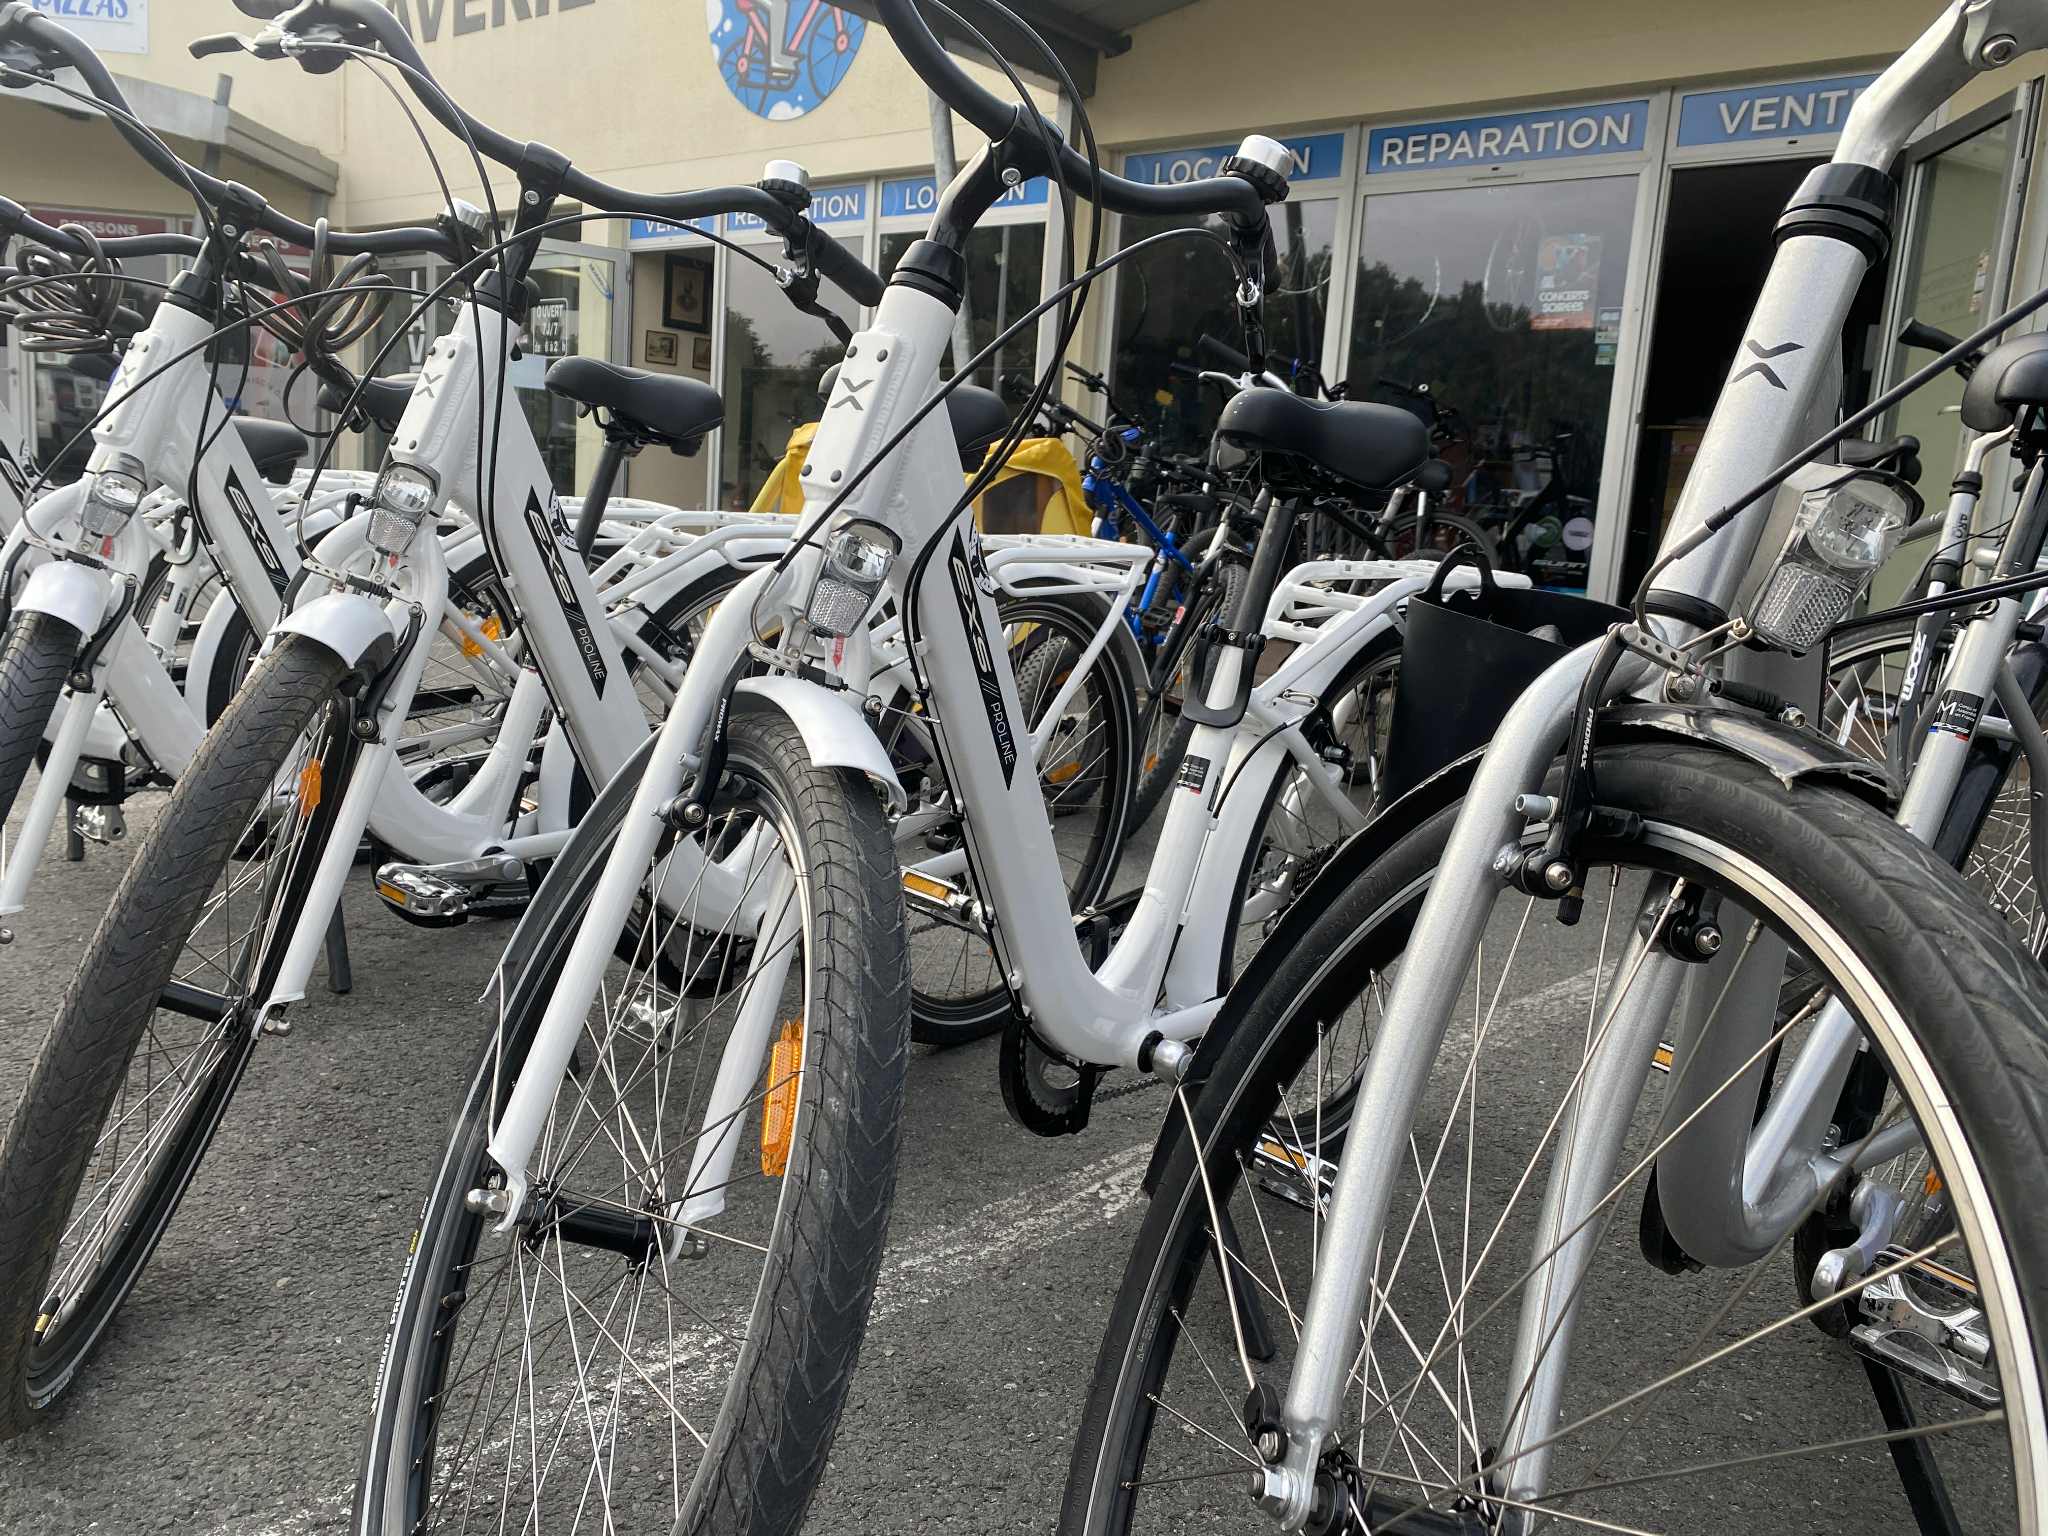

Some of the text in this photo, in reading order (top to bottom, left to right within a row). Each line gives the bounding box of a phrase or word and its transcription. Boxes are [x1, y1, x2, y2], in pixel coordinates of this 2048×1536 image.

[1719, 88, 1865, 134] VENT
[1381, 112, 1631, 167] REPARATION
[576, 627, 605, 680] PROLINE
[990, 701, 1015, 765] PROLINE
[1580, 706, 1594, 771] PROMAX
